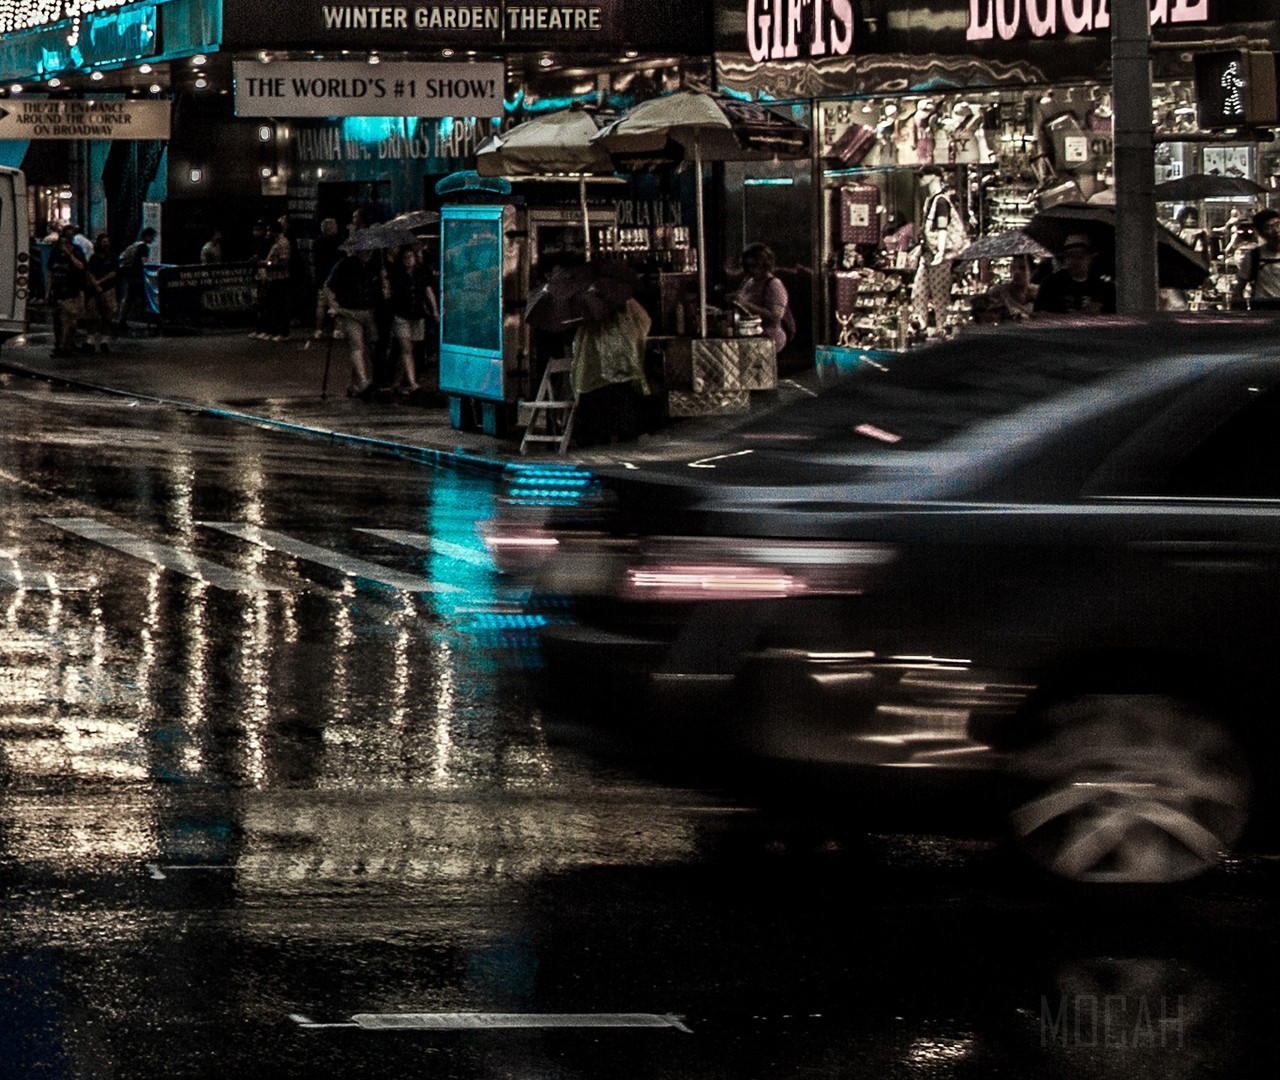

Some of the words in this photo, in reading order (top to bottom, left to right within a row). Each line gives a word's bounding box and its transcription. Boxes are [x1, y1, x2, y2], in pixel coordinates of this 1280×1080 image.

[322, 5, 408, 29] WINTER
[414, 6, 501, 30] GARDEN
[506, 6, 602, 30] THEATRE
[244, 78, 285, 99] THE
[292, 78, 386, 99] WORLD'S
[393, 78, 415, 99] #1
[426, 78, 496, 99] SHOW!
[16, 114, 61, 125] AROUND
[64, 114, 83, 124] THE
[90, 114, 132, 125] CORNER
[34, 125, 50, 136] ON
[53, 125, 114, 137] BROADWAY
[434, 118, 484, 158] HAPPIN
